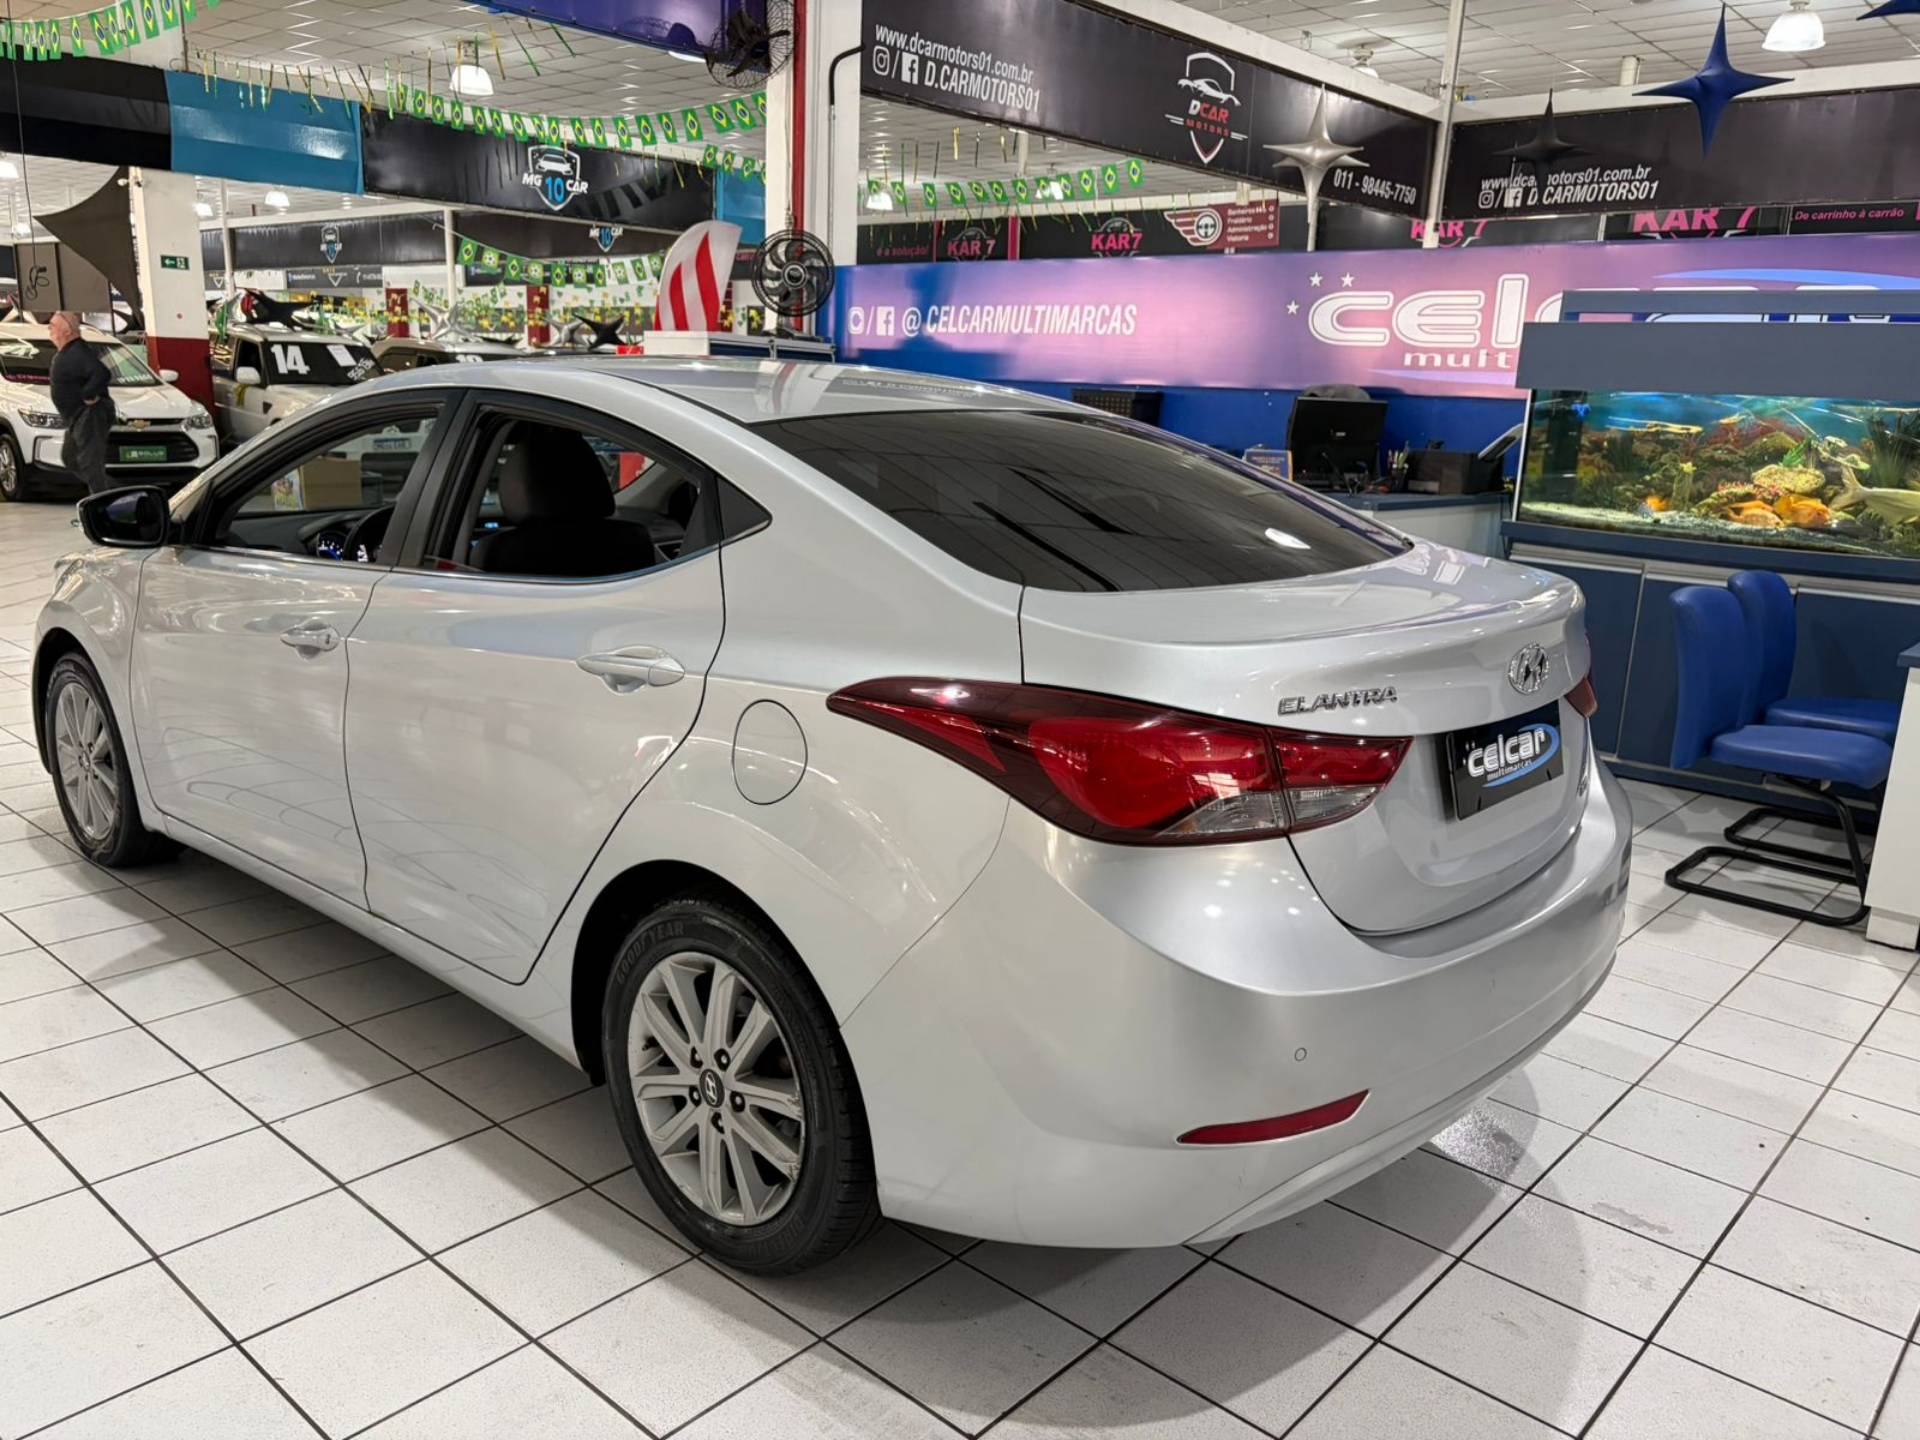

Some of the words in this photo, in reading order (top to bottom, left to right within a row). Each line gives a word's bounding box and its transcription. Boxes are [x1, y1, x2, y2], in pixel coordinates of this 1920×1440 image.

[875, 24, 1034, 84] www.dcarmotors01.com.br
[924, 60, 1040, 113] D.CARMOTORS01
[1188, 99, 1229, 123] DCAR
[522, 173, 543, 187] MG
[546, 176, 564, 205] 10
[566, 180, 589, 194] CAR
[1333, 168, 1354, 190] 011
[1361, 175, 1417, 205] 98445-7750
[1811, 208, 1857, 220] carrinho
[1868, 207, 1905, 218] carrão
[947, 240, 982, 256] KAR
[985, 240, 996, 255] 7
[926, 304, 1138, 335] CELCARMULTIMARCAS
[270, 344, 311, 375] 14
[1278, 686, 1398, 716] ELANTRA
[1468, 728, 1545, 777] celcar
